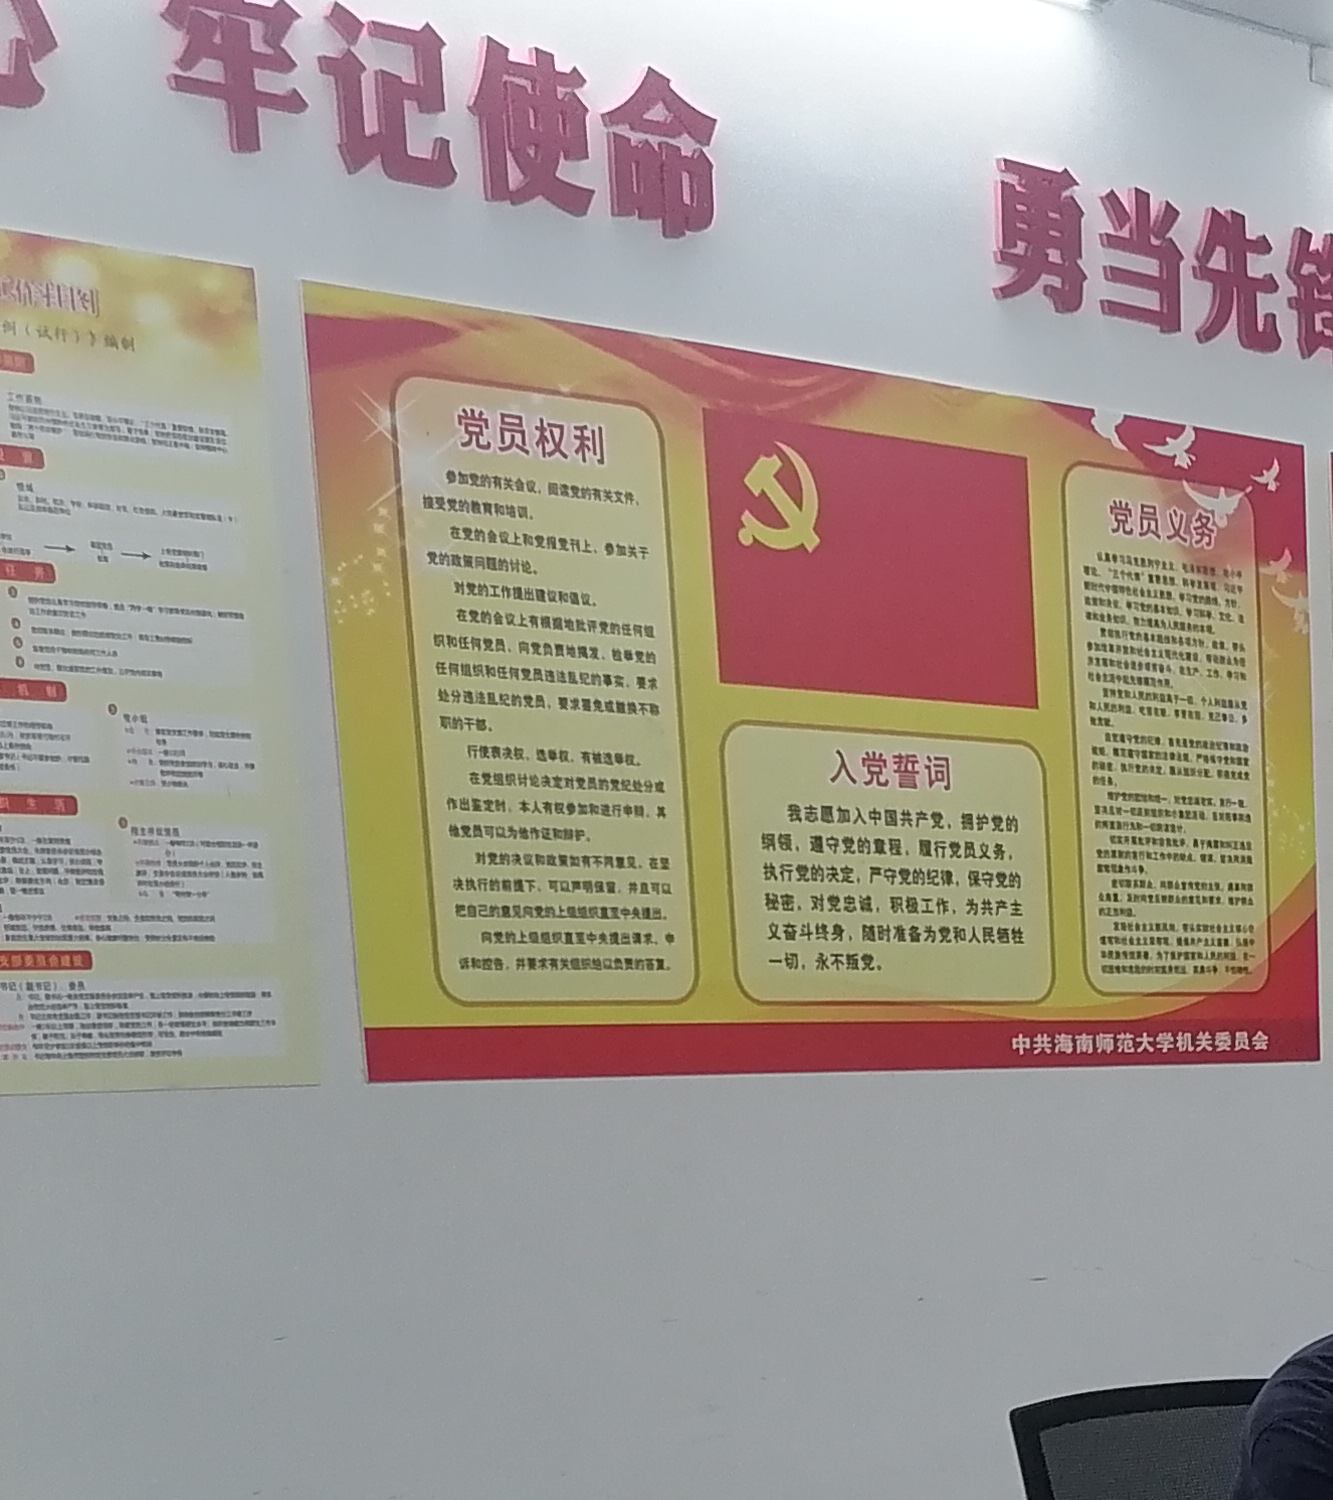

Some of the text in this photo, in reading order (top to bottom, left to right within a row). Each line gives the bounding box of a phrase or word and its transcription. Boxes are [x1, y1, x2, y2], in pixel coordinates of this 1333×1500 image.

[160, 0, 718, 239] 牢记使命
[457, 407, 606, 466] 党员权利
[1108, 499, 1217, 547] 党员义务
[829, 749, 953, 792] 入党誓词
[1011, 1030, 1270, 1057] 中共海南师范大学机关委员会
